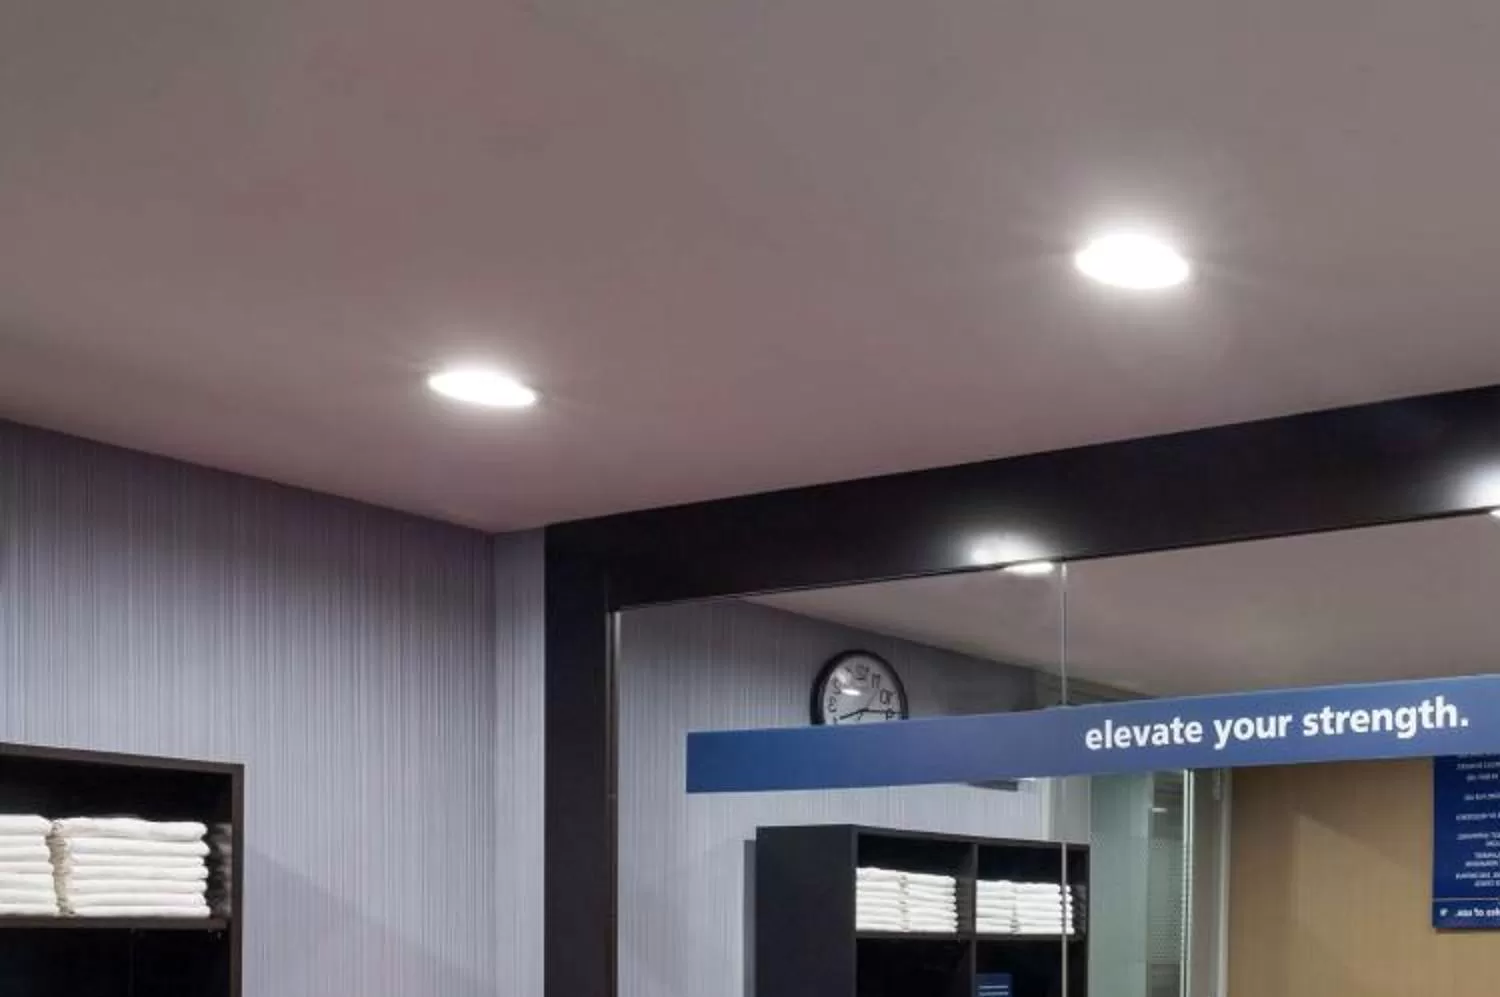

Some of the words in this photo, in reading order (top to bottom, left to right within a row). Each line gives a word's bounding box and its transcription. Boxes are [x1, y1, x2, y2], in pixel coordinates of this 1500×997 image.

[1085, 716, 1202, 751] elevate
[1213, 714, 1293, 750] your
[1303, 695, 1470, 739] strength.
